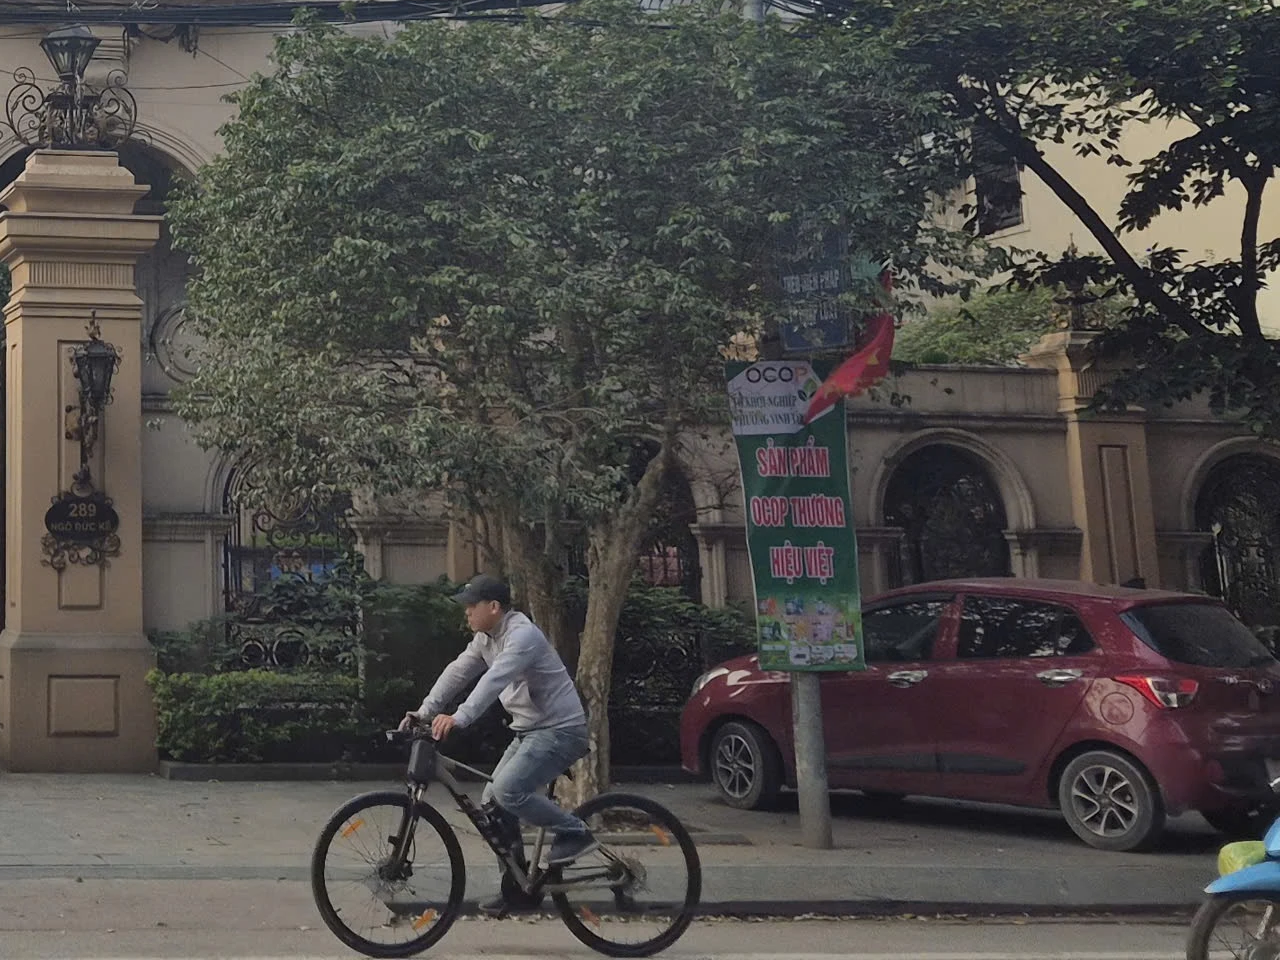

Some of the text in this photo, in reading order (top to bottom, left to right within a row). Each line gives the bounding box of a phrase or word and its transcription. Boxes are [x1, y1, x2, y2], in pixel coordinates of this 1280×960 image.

[746, 367, 808, 383] OCOP
[756, 436, 830, 477] SẢN PHẨM
[68, 503, 97, 517] 289
[751, 494, 845, 527] OCOP THƯƠNG
[50, 519, 72, 531] NGÔ
[769, 540, 834, 585] HIỆU VIỆT
